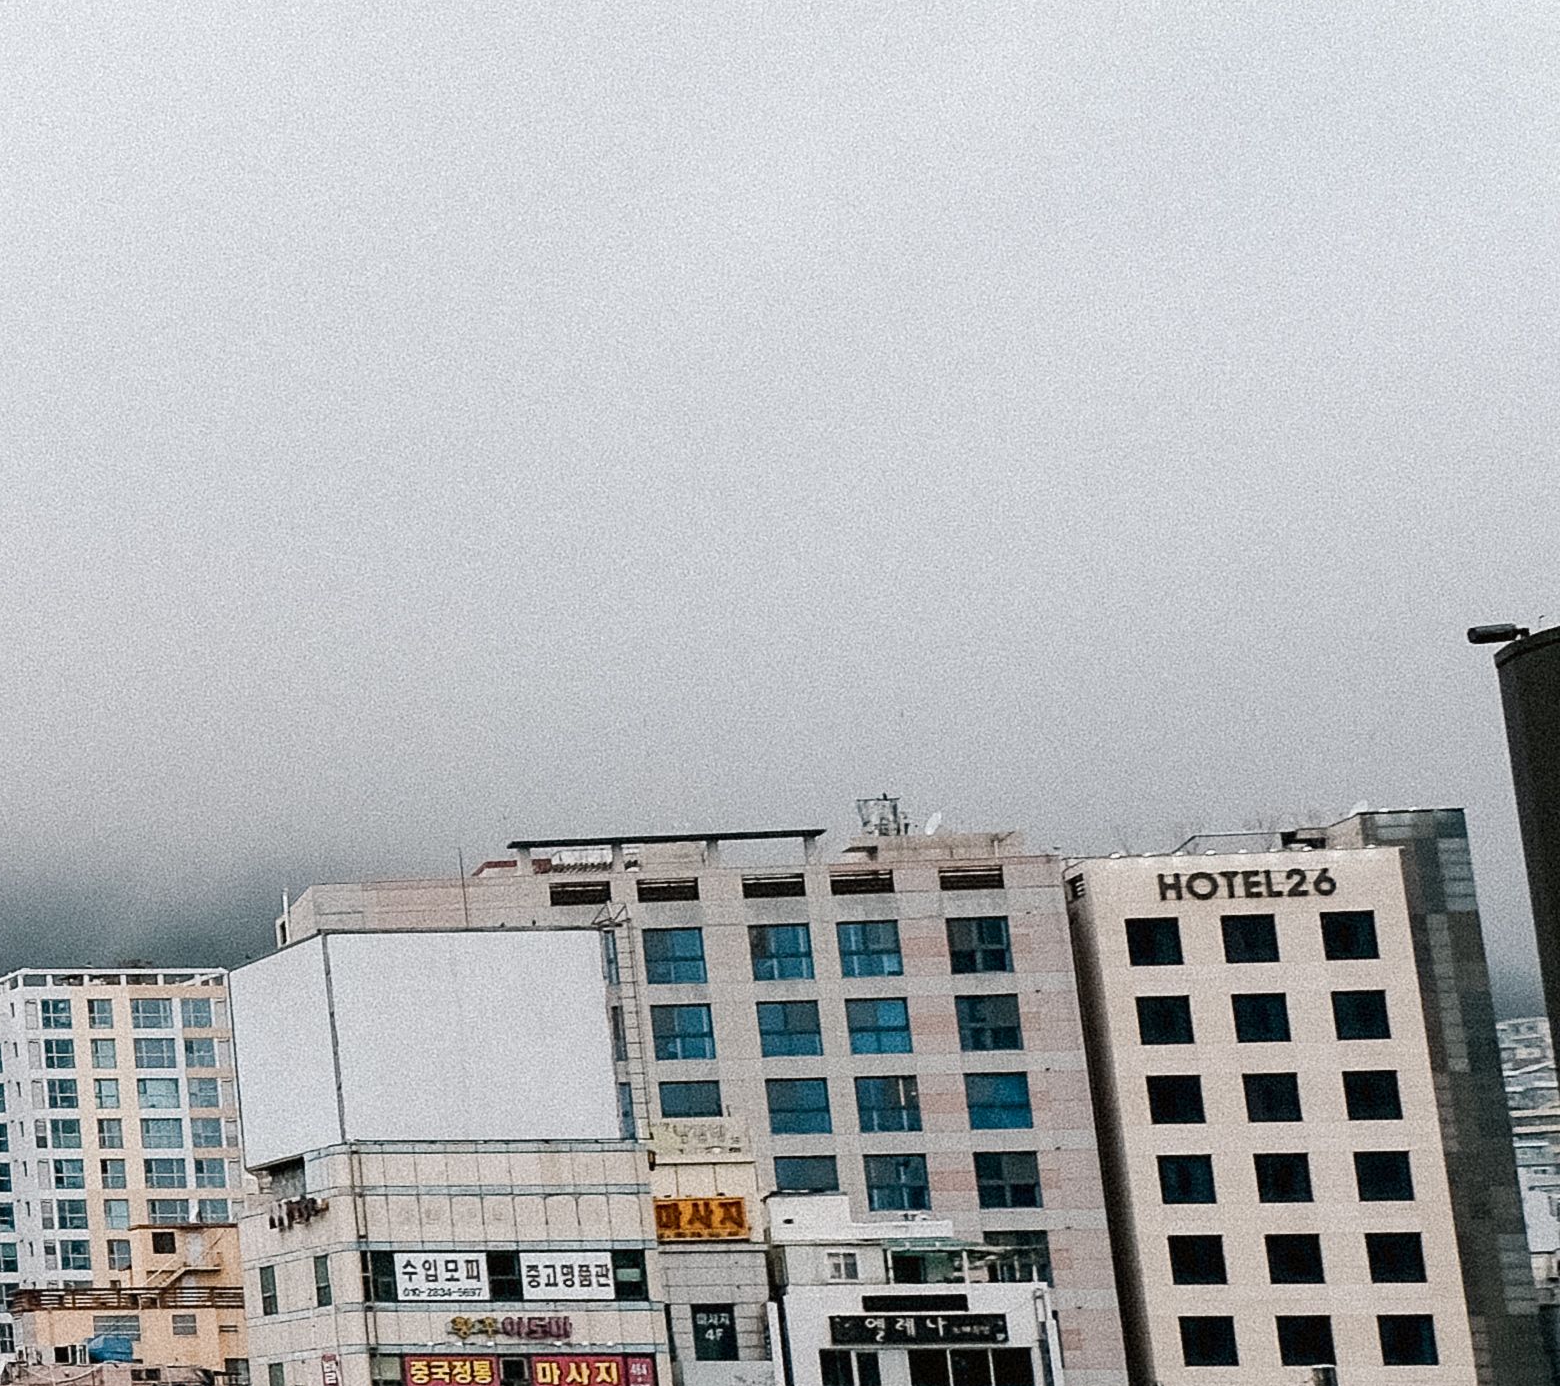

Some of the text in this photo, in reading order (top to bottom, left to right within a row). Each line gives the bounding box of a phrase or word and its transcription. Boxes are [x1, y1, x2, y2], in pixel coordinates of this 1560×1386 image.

[656, 1201, 745, 1230] 마사지
[524, 1262, 613, 1290] 중고명품관
[410, 1361, 493, 1384] 중국정통
[535, 1362, 619, 1386] 마사지
